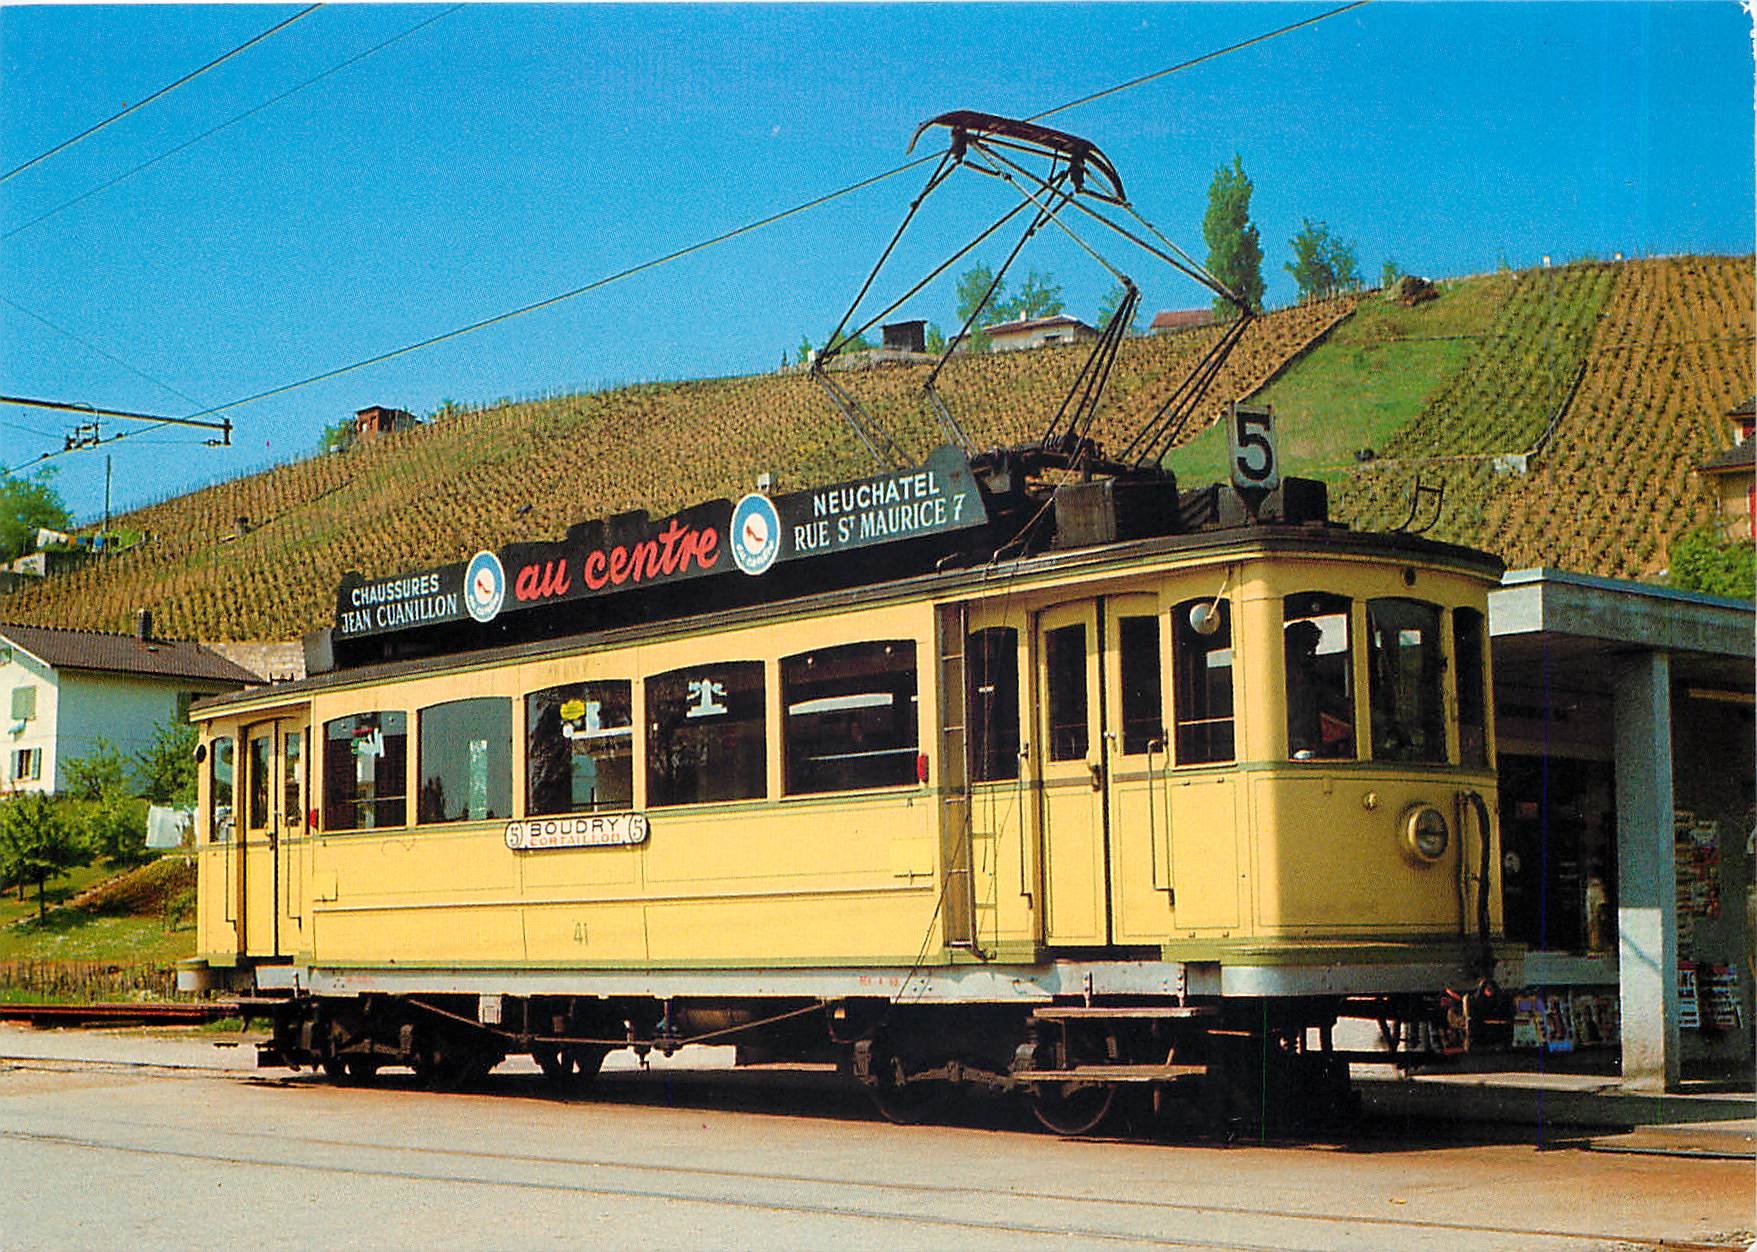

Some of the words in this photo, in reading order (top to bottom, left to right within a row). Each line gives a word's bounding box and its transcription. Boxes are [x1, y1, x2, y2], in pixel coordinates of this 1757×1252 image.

[1236, 411, 1274, 482] 5
[813, 471, 941, 518] NEUCHATEL
[794, 520, 831, 551] RUE
[860, 498, 948, 539] MAURICE
[952, 493, 967, 521] 7
[514, 558, 572, 602] au
[584, 518, 721, 590] centre
[351, 573, 440, 607] CHAUSSURES
[340, 609, 372, 633] JEAN
[376, 593, 458, 628] CUANILLON
[509, 826, 520, 848] 5
[530, 818, 619, 837] BOUDRY
[632, 818, 644, 841] 5
[573, 921, 589, 945] 41
